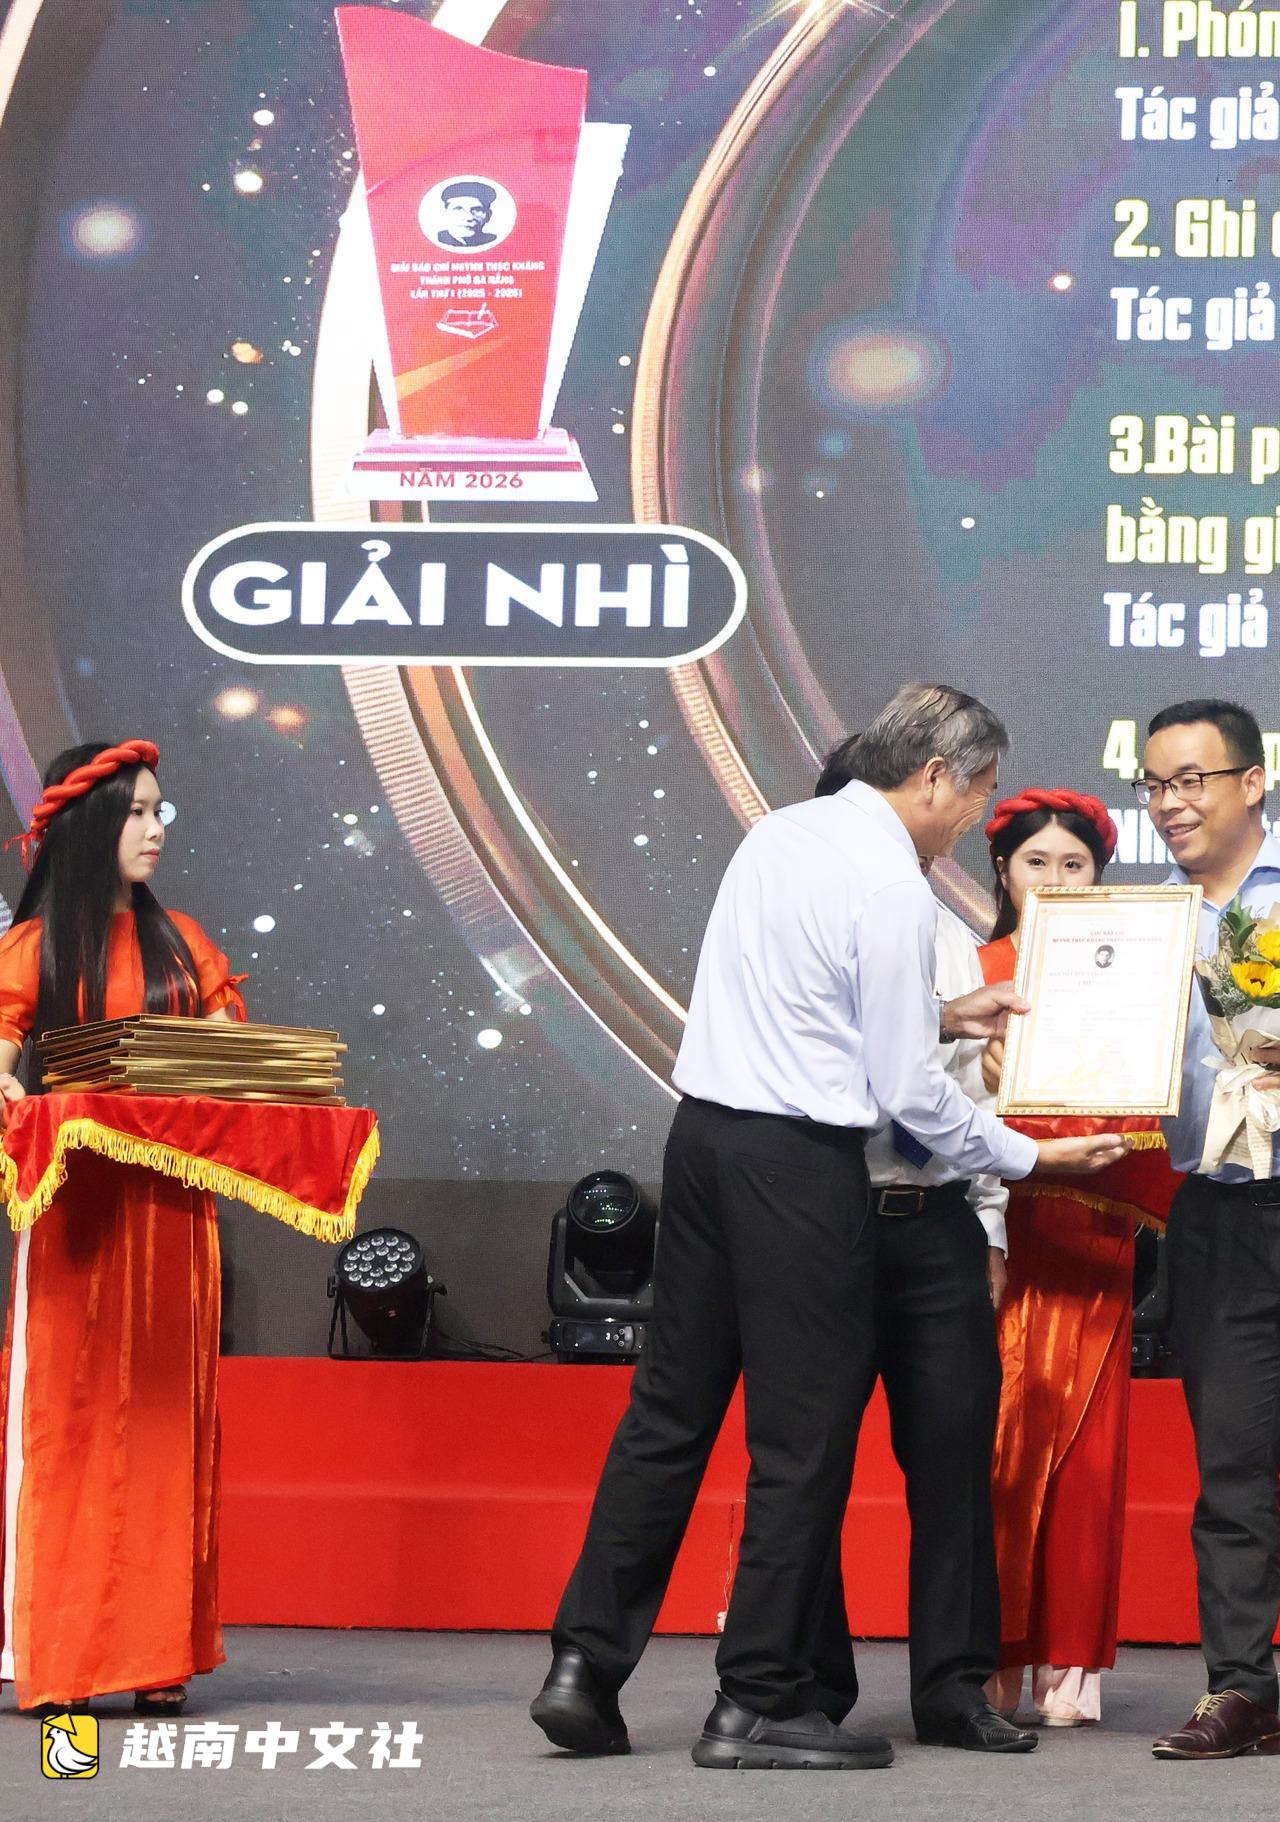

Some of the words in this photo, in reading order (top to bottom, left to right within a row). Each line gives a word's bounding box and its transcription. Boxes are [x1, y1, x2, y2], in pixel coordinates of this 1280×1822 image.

[1114, 86, 1197, 141] Tác
[1209, 81, 1280, 150] giả
[1113, 200, 1161, 258] 2.
[1175, 199, 1256, 258] Ghi
[1110, 285, 1192, 341] Tác
[1205, 281, 1275, 351] giả
[399, 468, 456, 489] NĂM
[464, 471, 524, 489] 2026
[1106, 496, 1228, 574] bằng
[209, 539, 447, 627] GIẢI
[485, 543, 691, 628] NHÌ
[1103, 591, 1186, 647] Tác
[1198, 587, 1269, 658] giả
